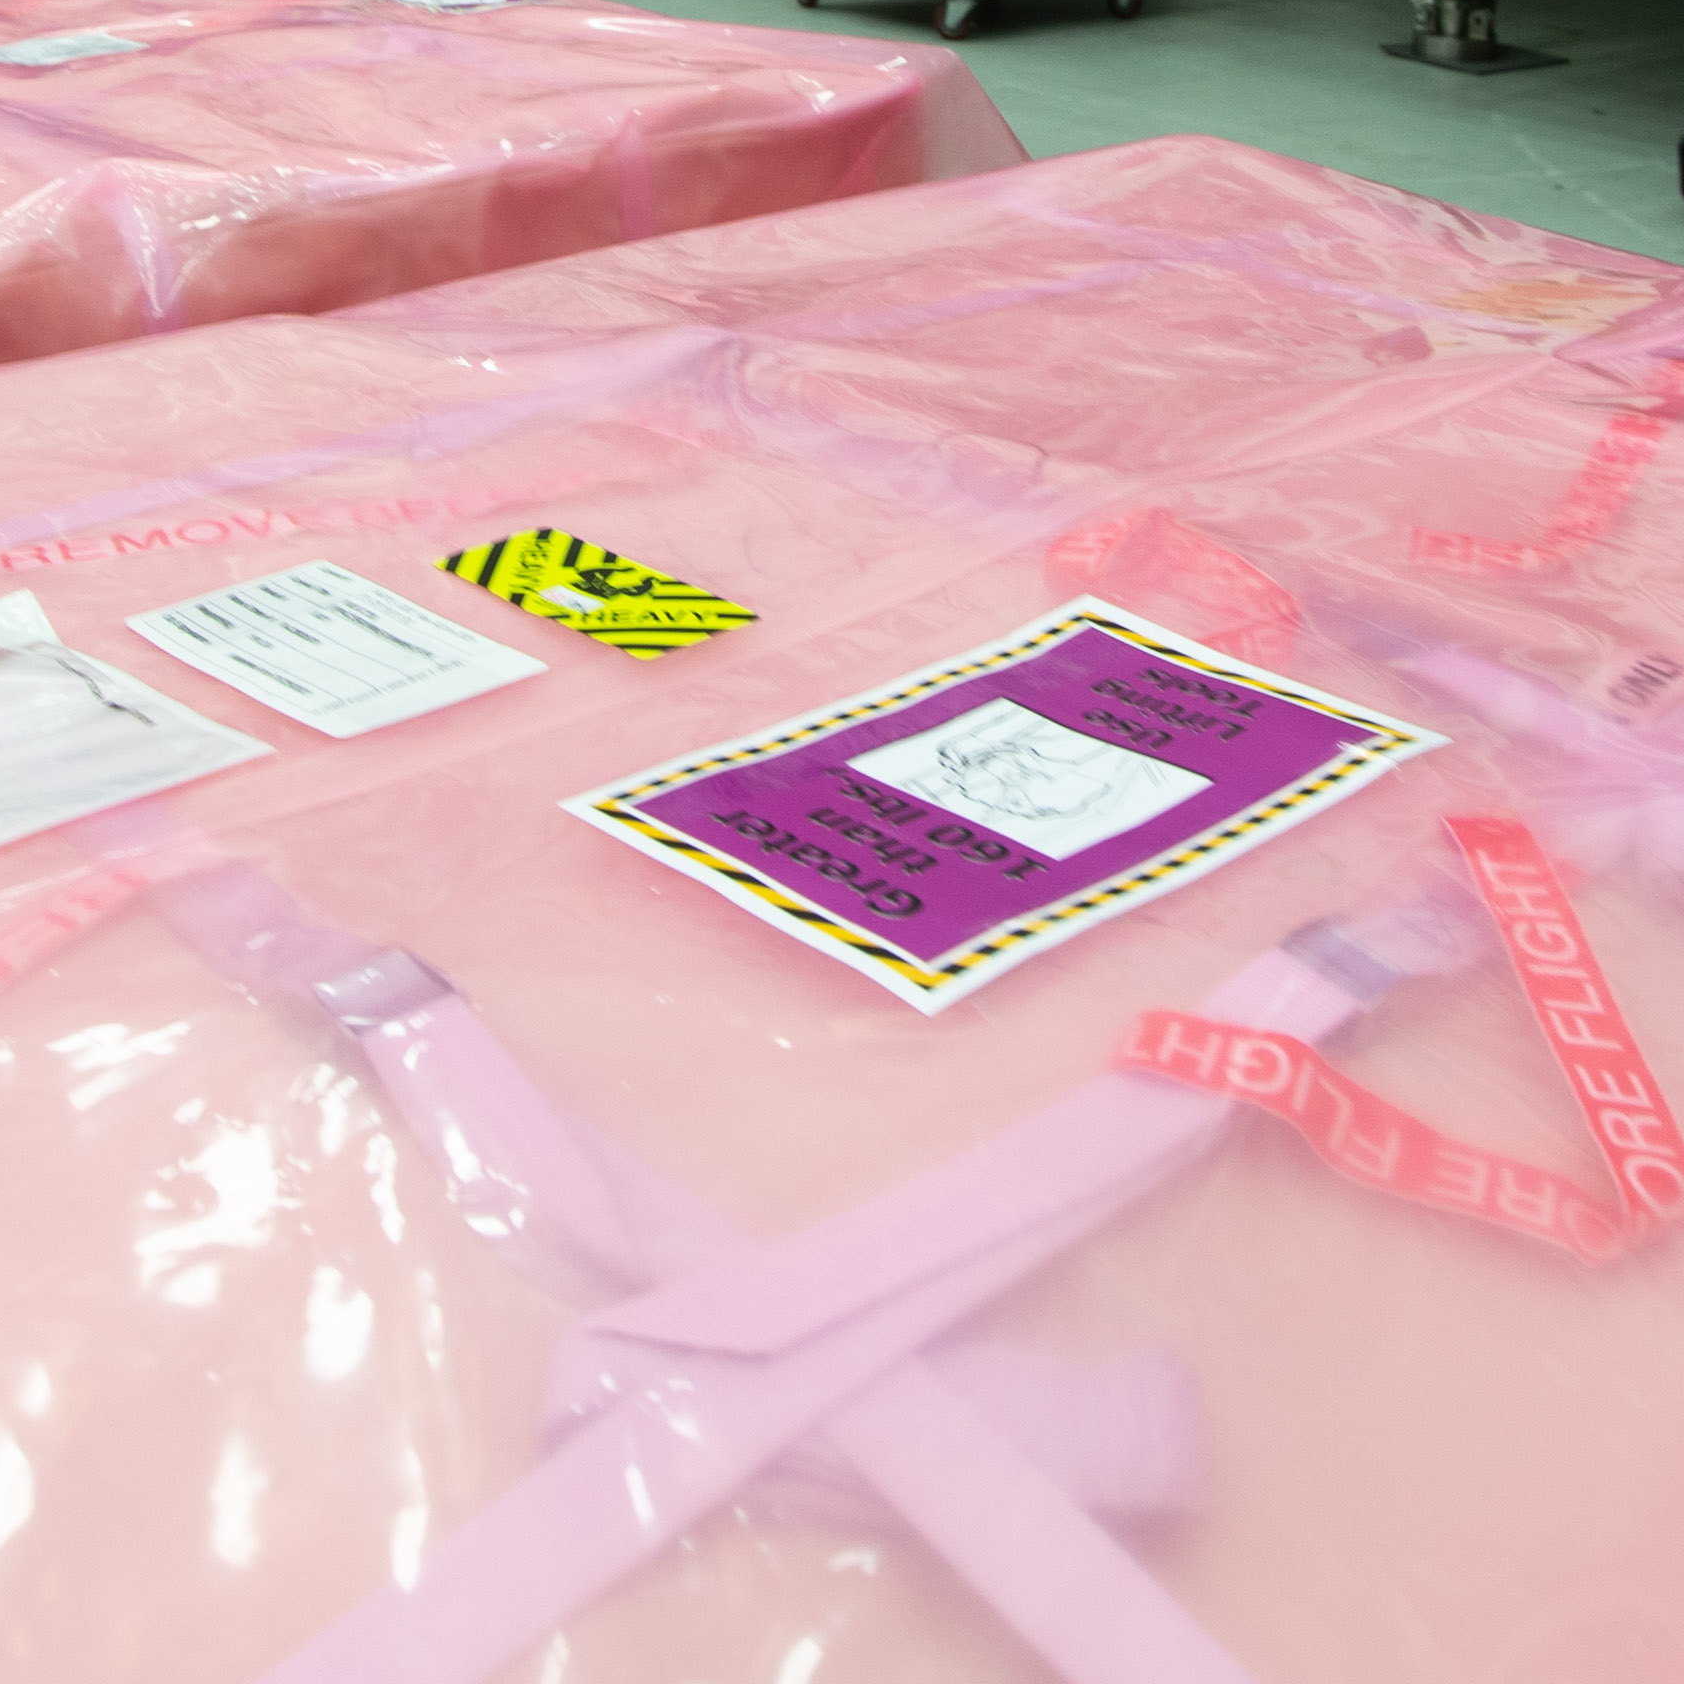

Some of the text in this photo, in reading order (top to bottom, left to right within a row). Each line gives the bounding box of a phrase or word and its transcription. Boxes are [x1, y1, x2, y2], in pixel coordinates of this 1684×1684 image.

[1082, 708, 1174, 752] Use
[709, 809, 925, 918] Greater
[807, 807, 938, 876] than
[926, 823, 1049, 882] 160
[1476, 846, 1623, 1052] FLIGHT
[1121, 1019, 1403, 1182] FLIGHT
